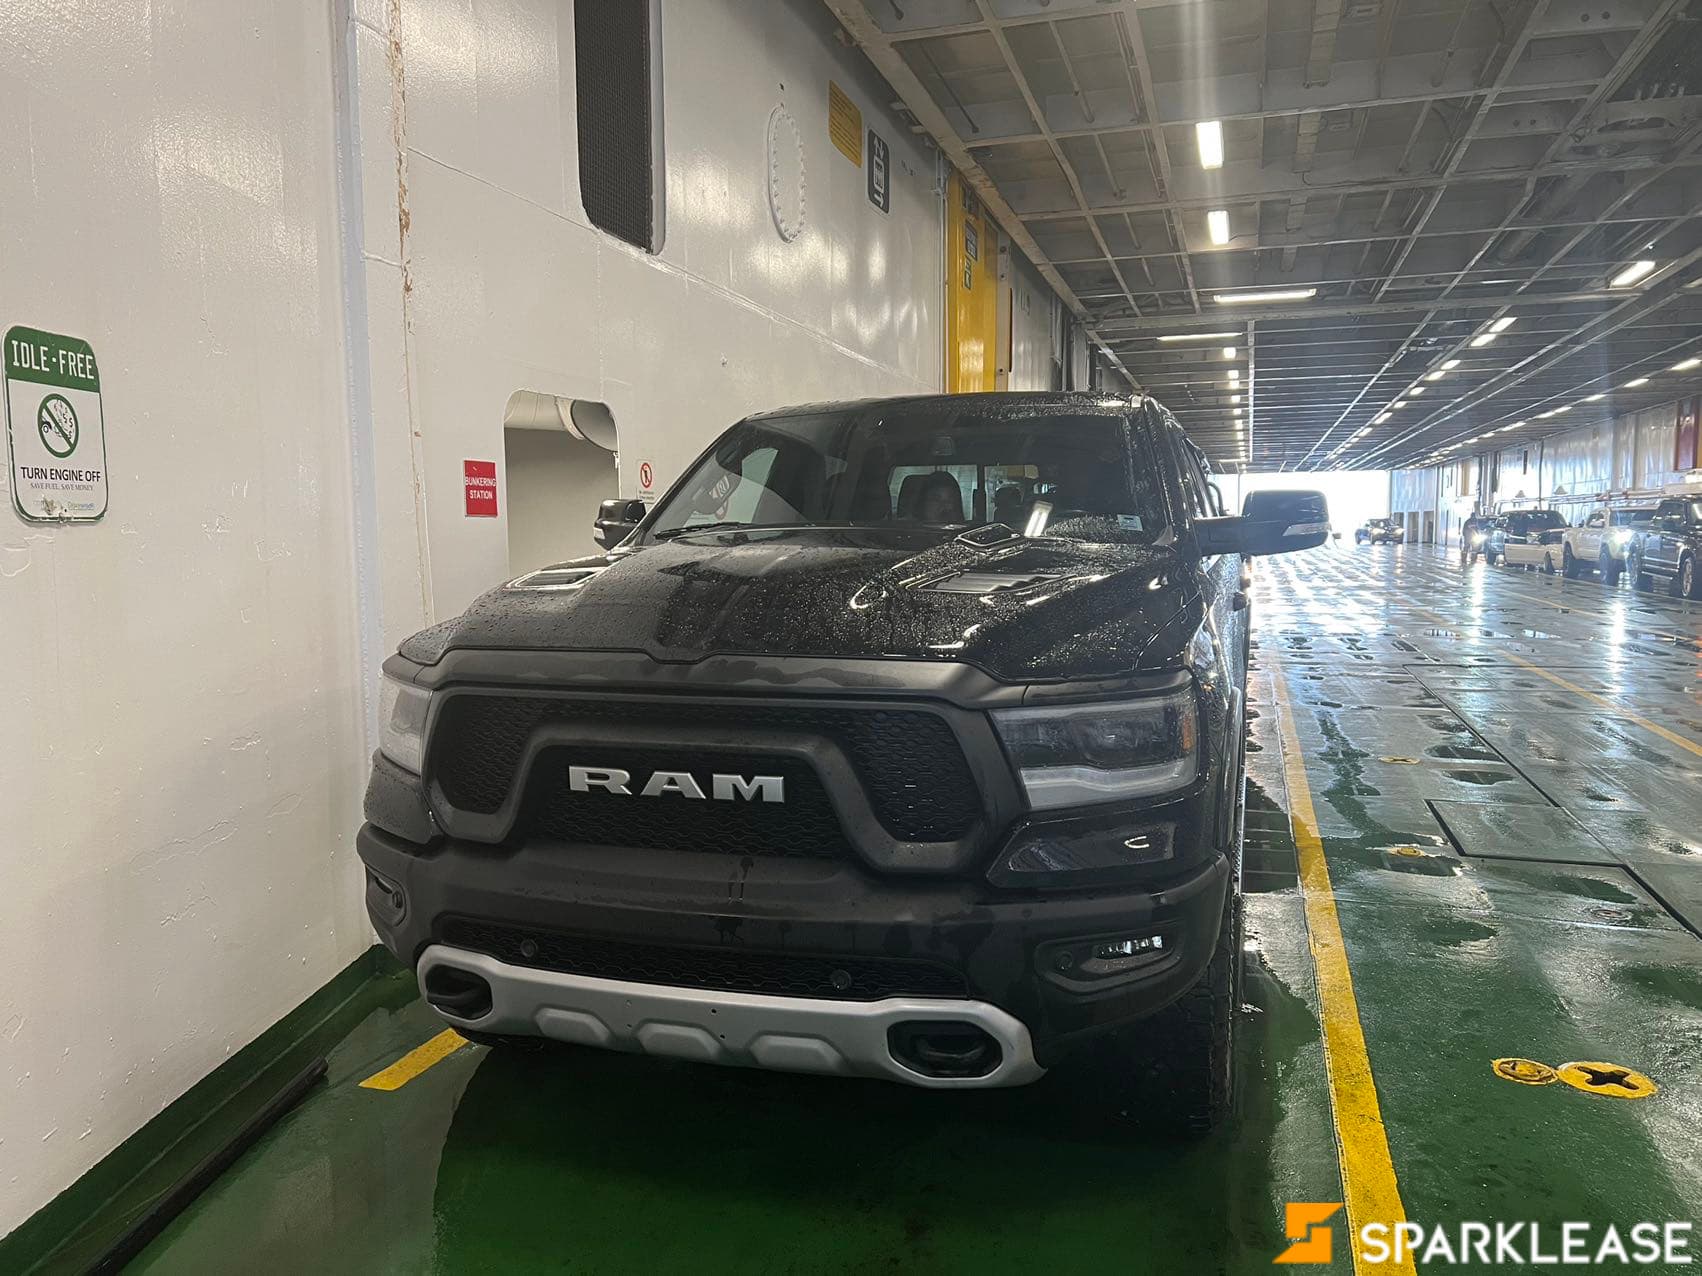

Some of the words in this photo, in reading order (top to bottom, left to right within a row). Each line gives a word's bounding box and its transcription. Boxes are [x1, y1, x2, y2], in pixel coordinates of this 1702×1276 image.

[20, 466, 48, 480] TURN
[49, 468, 84, 481] ENGINE
[84, 470, 101, 482] OFF
[30, 482, 46, 490] SAVE
[74, 484, 94, 492] MONEY
[465, 475, 497, 487] BUNKERING
[469, 489, 493, 500] STATION
[568, 765, 785, 803] RAM
